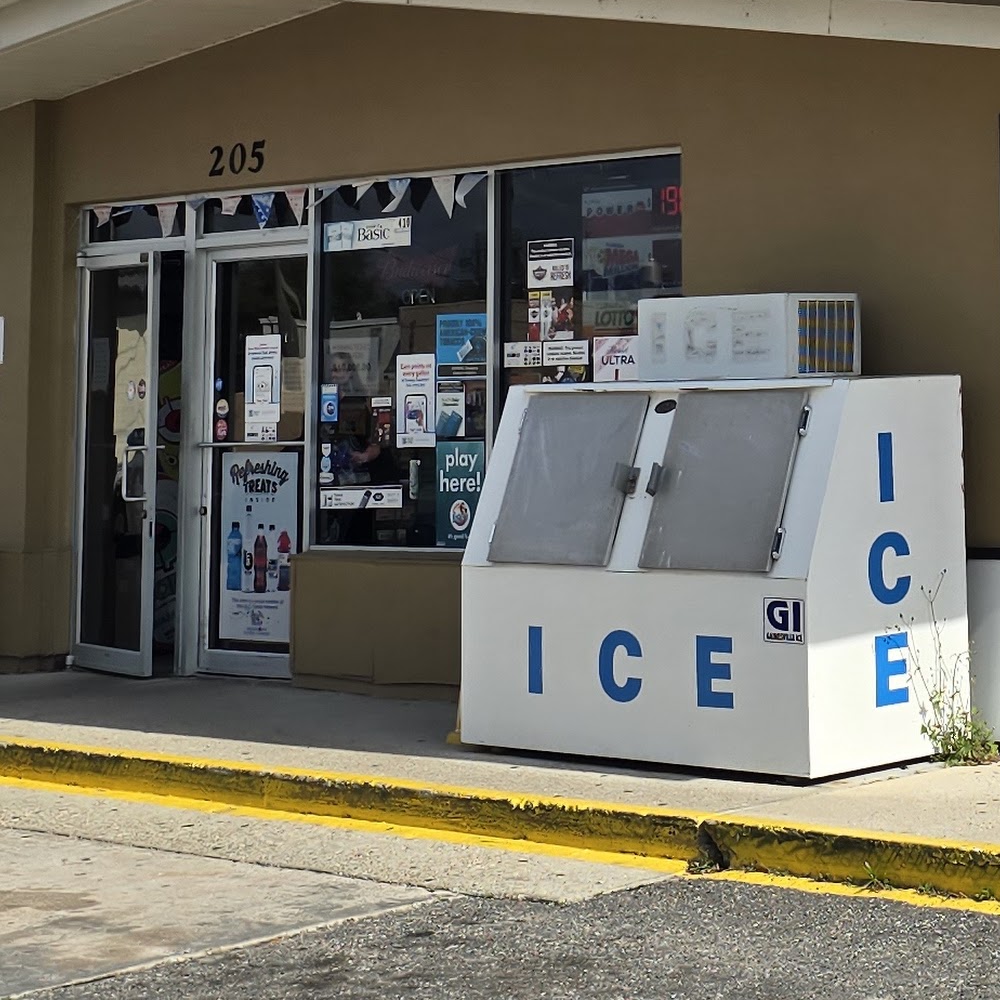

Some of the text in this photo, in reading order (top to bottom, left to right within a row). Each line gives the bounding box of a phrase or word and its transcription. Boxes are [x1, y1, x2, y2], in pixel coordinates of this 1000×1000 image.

[209, 139, 266, 177] 205
[357, 227, 390, 242] Basic
[594, 310, 635, 327] LOTTO
[601, 354, 636, 366] ULTRA
[230, 458, 289, 486] Refreshing
[445, 447, 478, 472] play
[243, 478, 278, 493] TREATS
[439, 469, 481, 492] here!
[868, 432, 912, 708] ICE
[766, 600, 801, 632] GI
[528, 625, 735, 709] ICE
